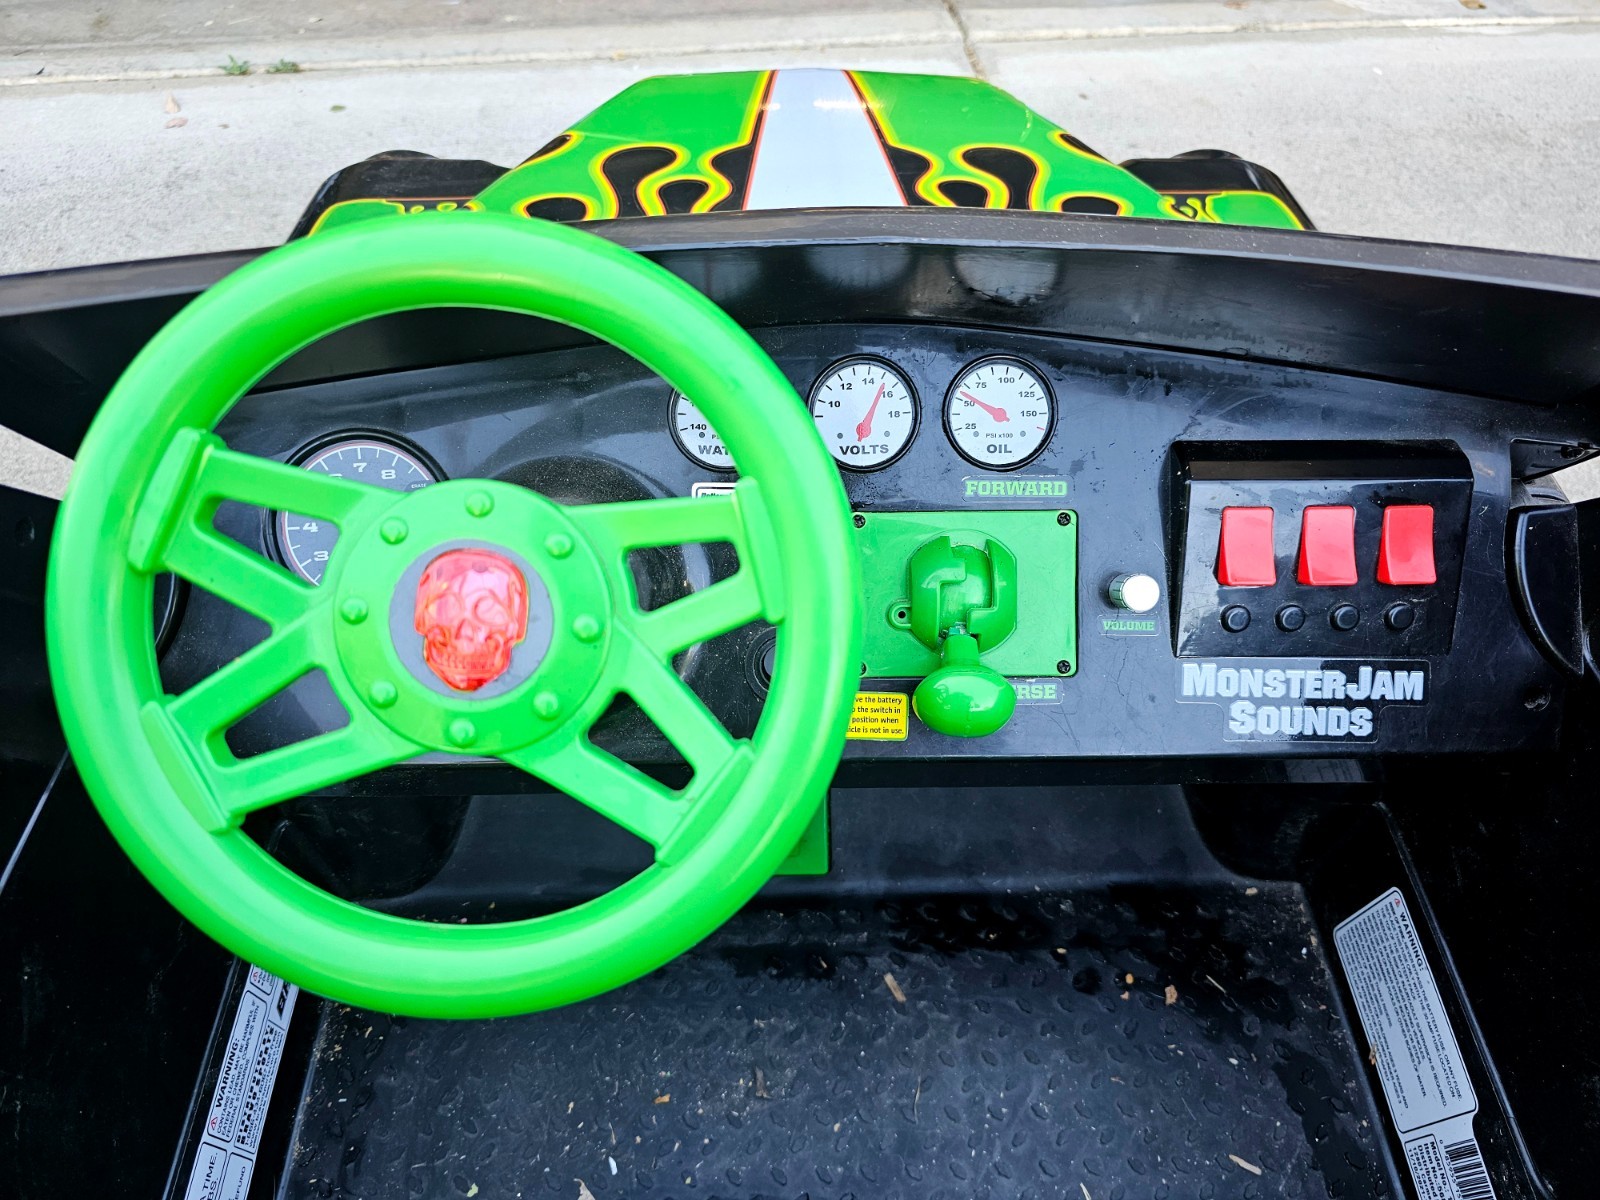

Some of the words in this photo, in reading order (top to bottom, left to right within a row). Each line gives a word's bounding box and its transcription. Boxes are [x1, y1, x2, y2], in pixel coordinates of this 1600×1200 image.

[839, 444, 889, 455] VOLTS
[986, 444, 1012, 454] OIL
[353, 462, 367, 472] 7
[381, 470, 396, 479] 8
[965, 481, 1068, 496] FORWARD
[302, 522, 318, 532] 4
[313, 551, 329, 561] 3
[1102, 620, 1156, 632] VOLUME
[1012, 684, 1056, 699] RSE
[878, 697, 902, 705] battery
[1229, 700, 1373, 737] SOUNDS
[1400, 912, 1423, 971] WARNING:
[216, 1038, 239, 1107] WARNING:
[217, 1096, 230, 1133] CONTAINS
[222, 1111, 231, 1135] EATEN
[229, 1098, 234, 1109] OR
[1424, 1143, 1433, 1164] Item
[1430, 1142, 1442, 1170] Model
[202, 1153, 217, 1190] TIME.
[1418, 1145, 1438, 1197] Distributed
